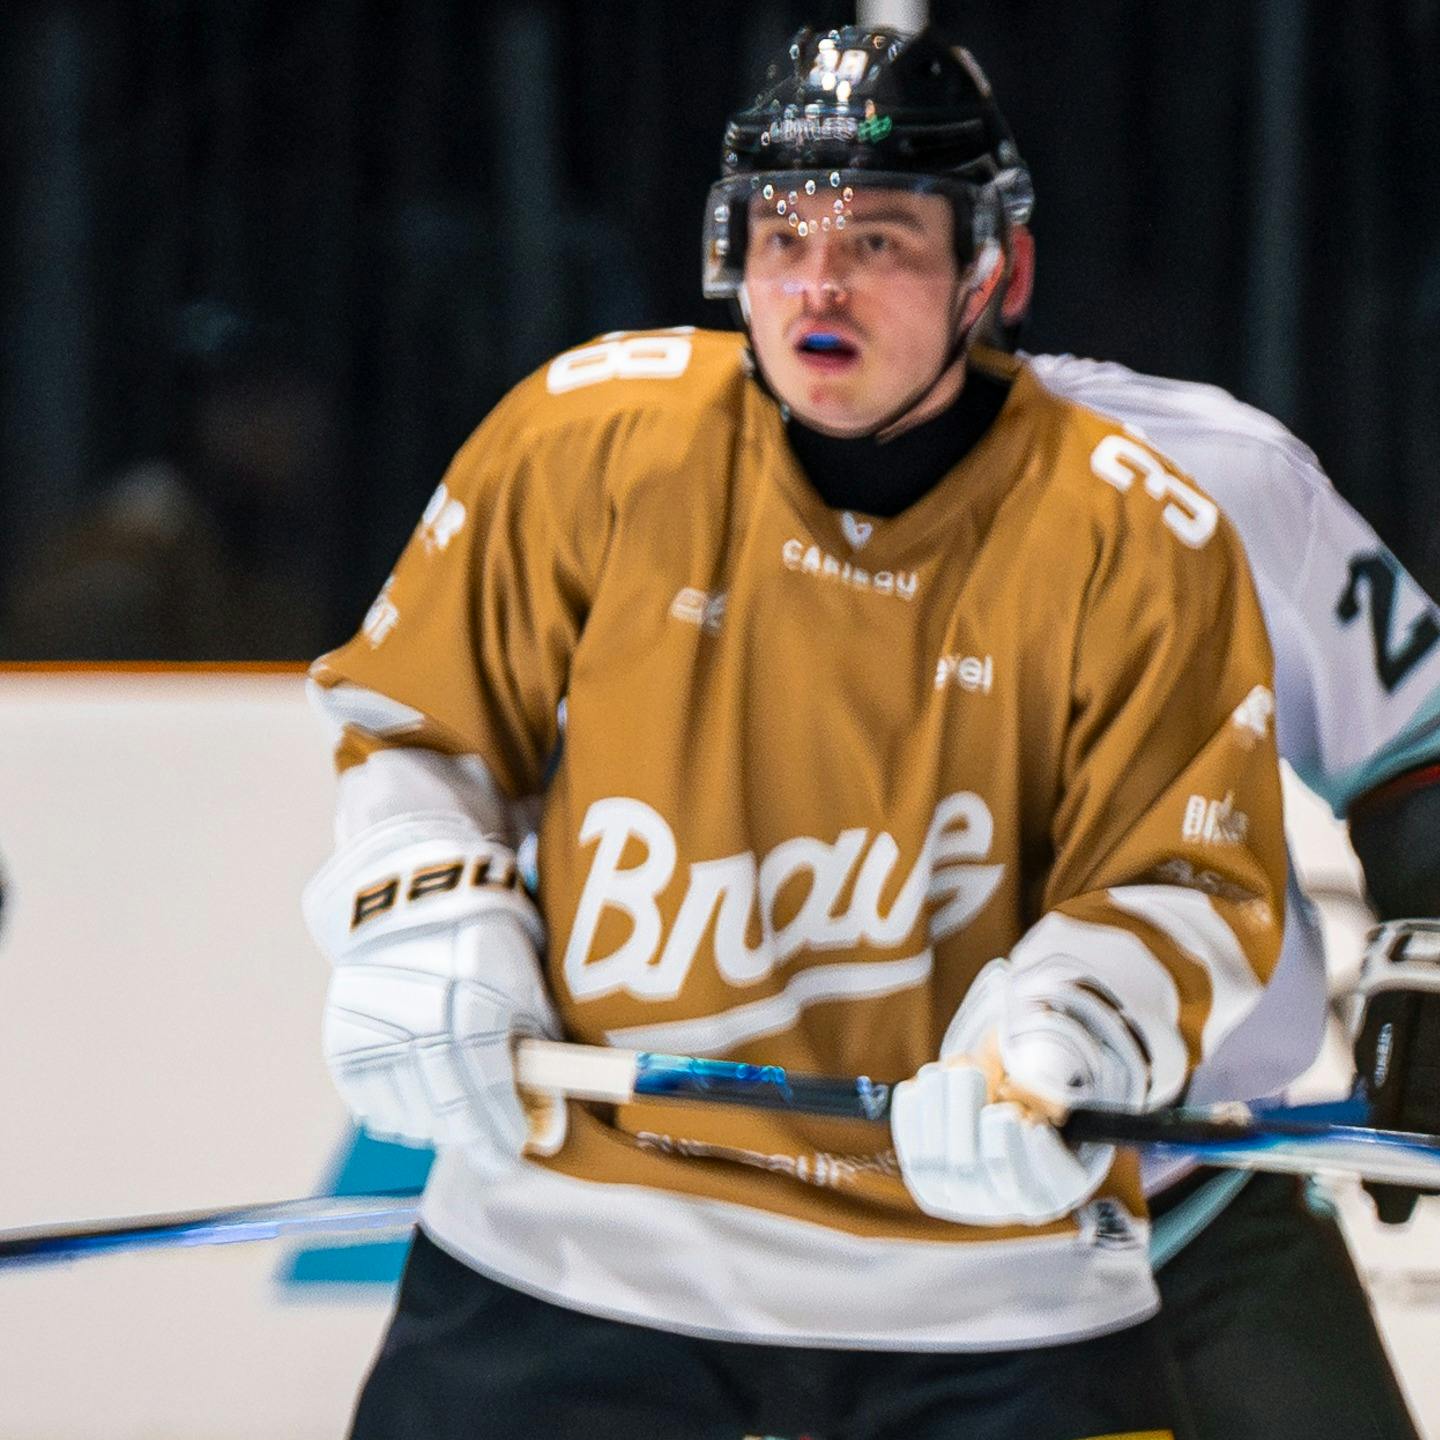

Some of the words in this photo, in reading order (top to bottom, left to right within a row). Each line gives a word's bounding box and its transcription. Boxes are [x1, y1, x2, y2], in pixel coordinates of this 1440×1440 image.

[546, 324, 696, 396] 8
[1089, 424, 1219, 550] 3
[561, 791, 1006, 1003] Brave
